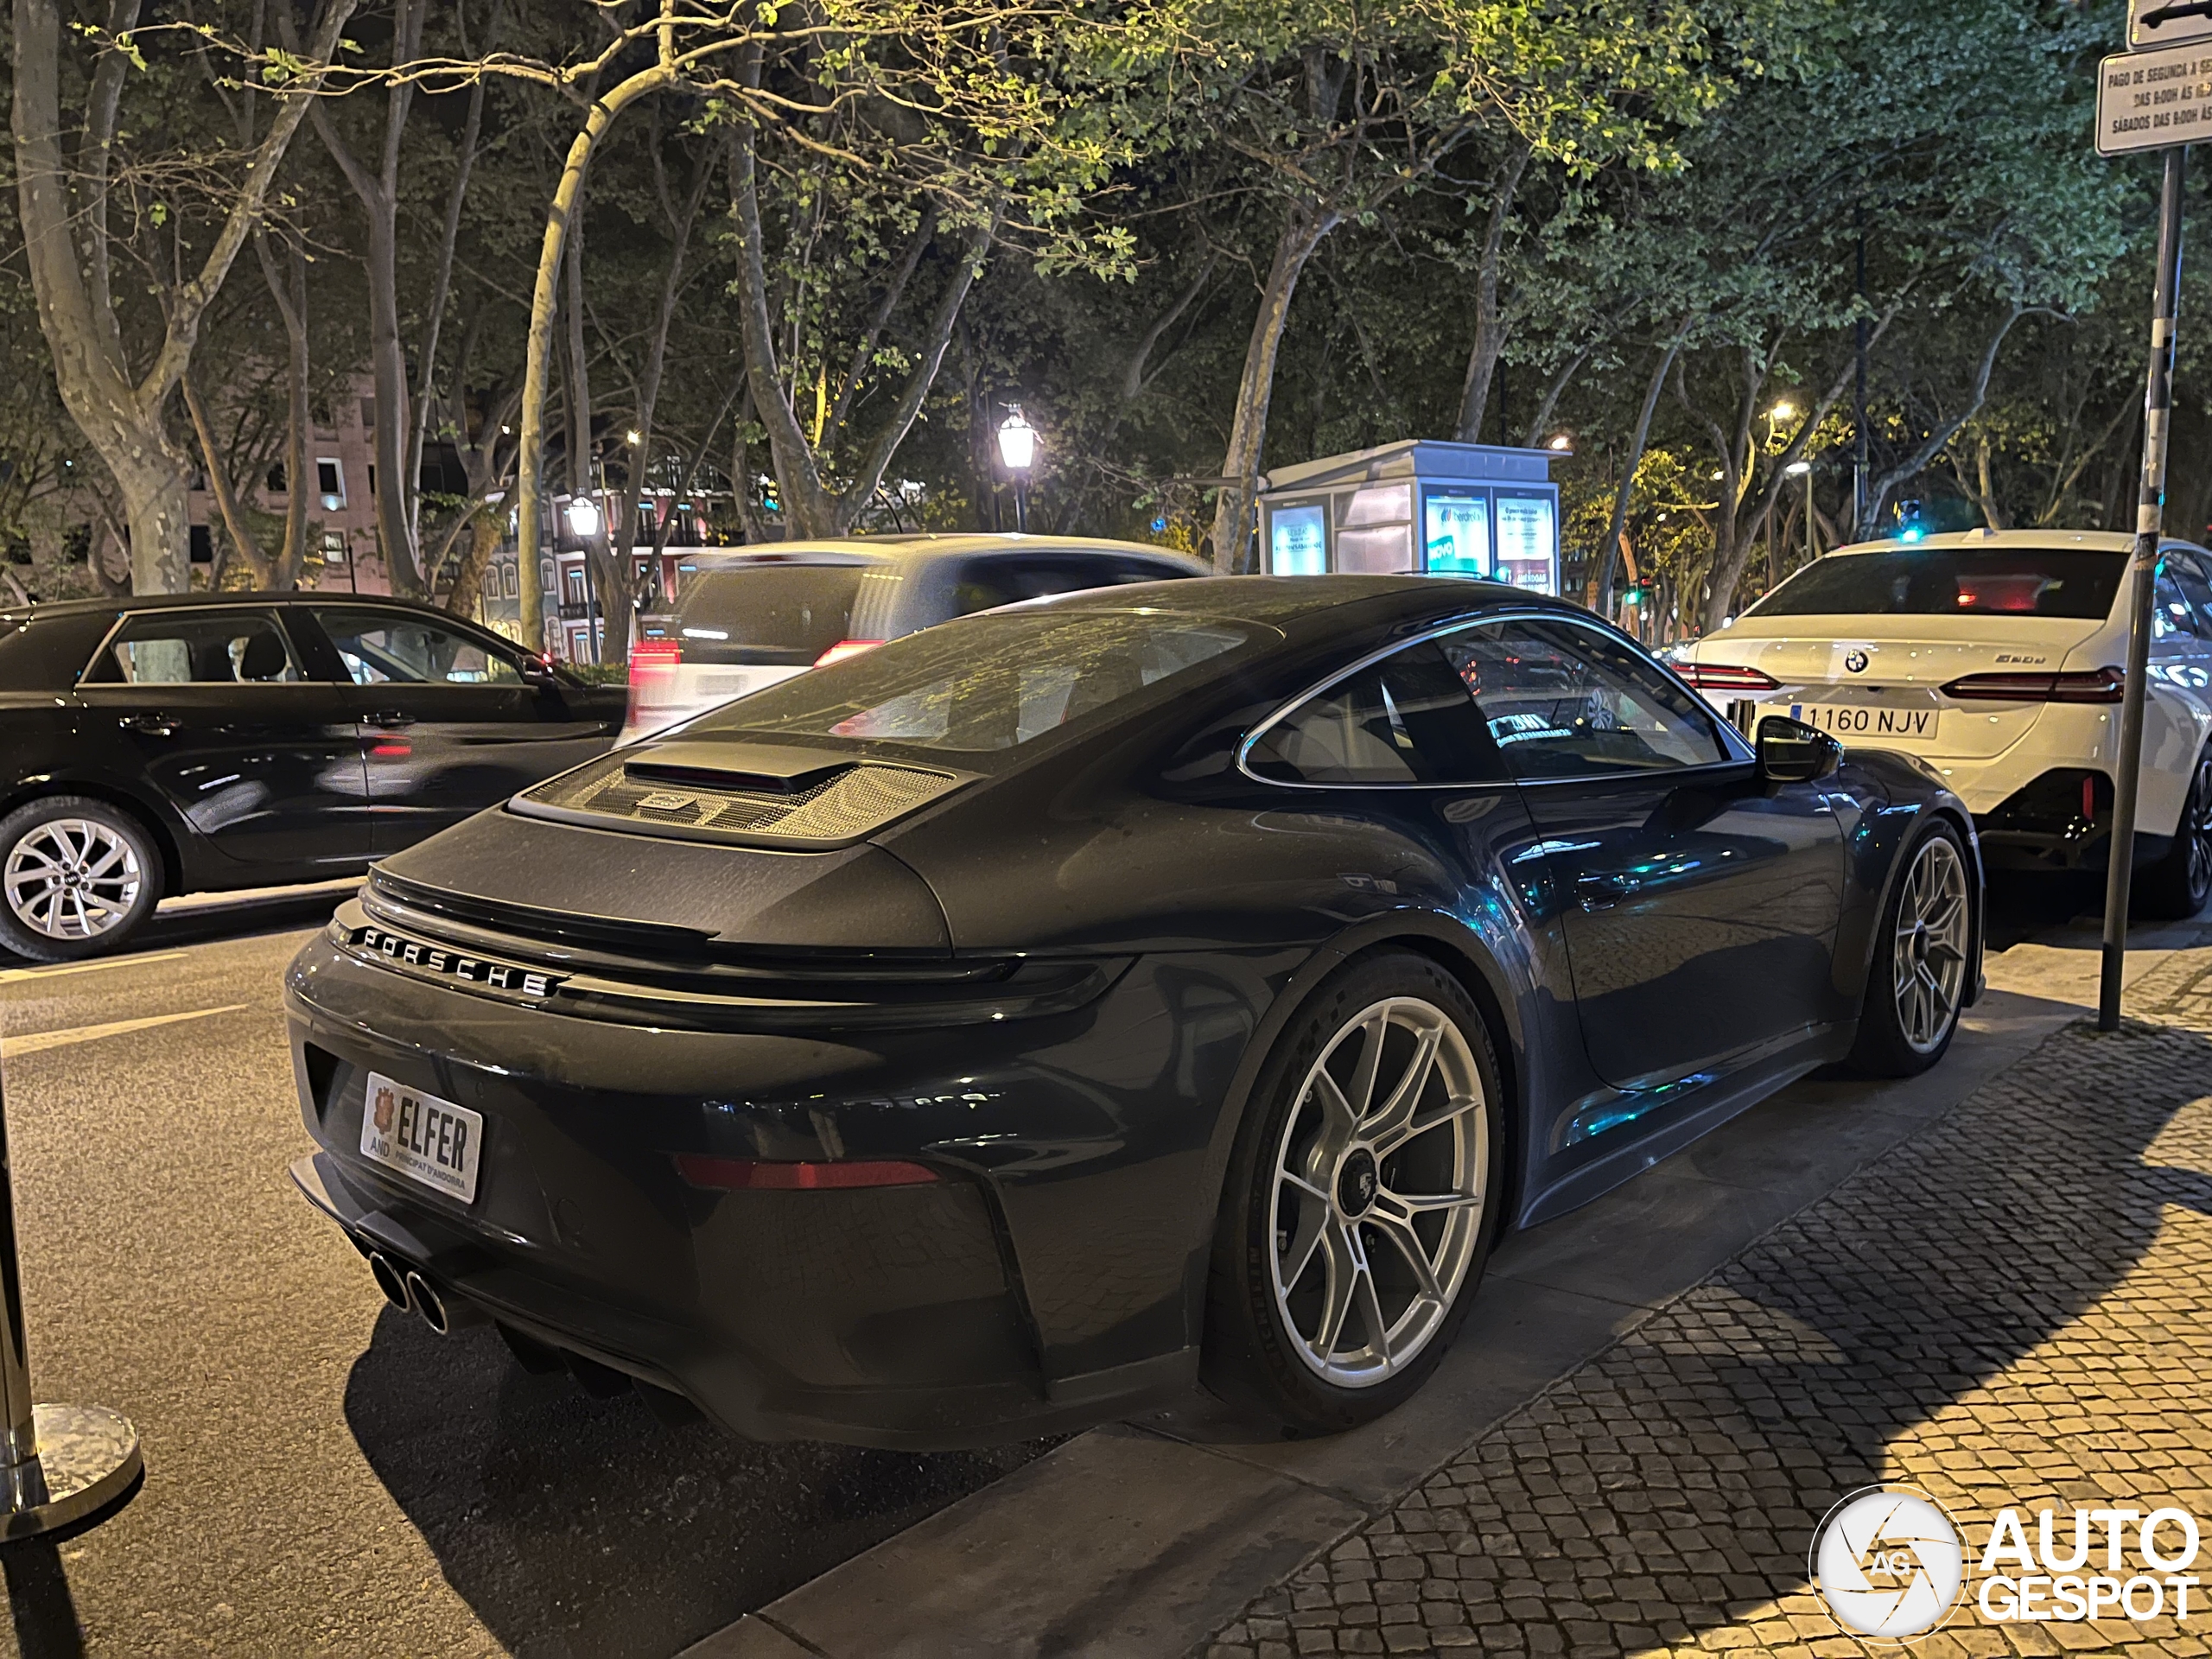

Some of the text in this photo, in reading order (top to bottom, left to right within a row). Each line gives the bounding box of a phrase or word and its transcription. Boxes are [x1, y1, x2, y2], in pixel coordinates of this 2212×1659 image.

[2108, 72, 2130, 88] PAGO
[2133, 70, 2144, 84] DE
[2147, 63, 2187, 82] SEGUNDA
[2190, 61, 2196, 75] A
[2133, 92, 2151, 107] DAS
[2113, 115, 2150, 133] SÁBADOS
[2154, 112, 2170, 129] DAS
[1428, 542, 1453, 561] NOVO
[1809, 708, 1929, 734] 1160 NJV
[364, 929, 550, 996] PORSCHE
[397, 1096, 467, 1173] ELFER
[370, 1137, 390, 1157] AND
[396, 1150, 427, 1171] PRINCIPAT
